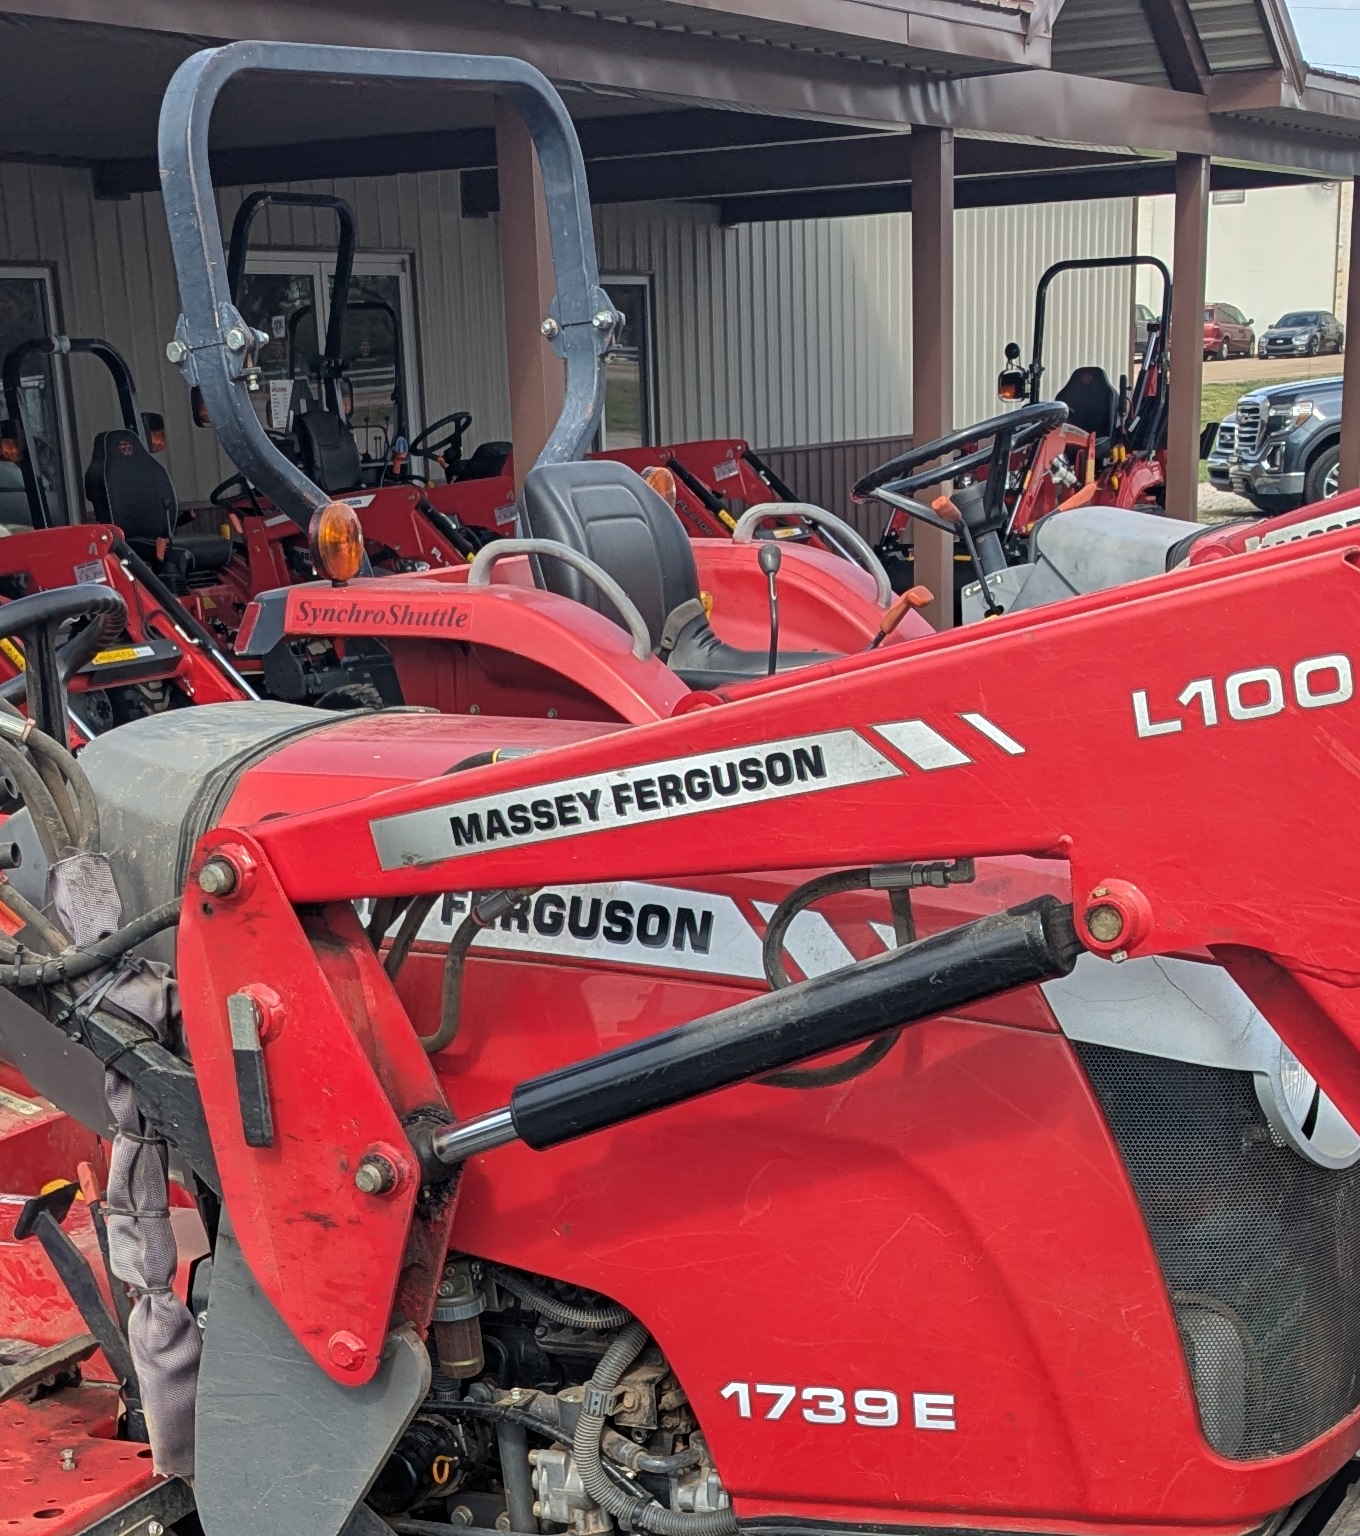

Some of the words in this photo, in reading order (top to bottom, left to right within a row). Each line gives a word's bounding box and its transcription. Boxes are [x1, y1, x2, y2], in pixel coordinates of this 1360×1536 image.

[296, 600, 469, 628] SynchroShuttle
[1132, 652, 1354, 738] L100
[449, 788, 601, 848] MASSEY
[611, 744, 828, 818] FERGUSON
